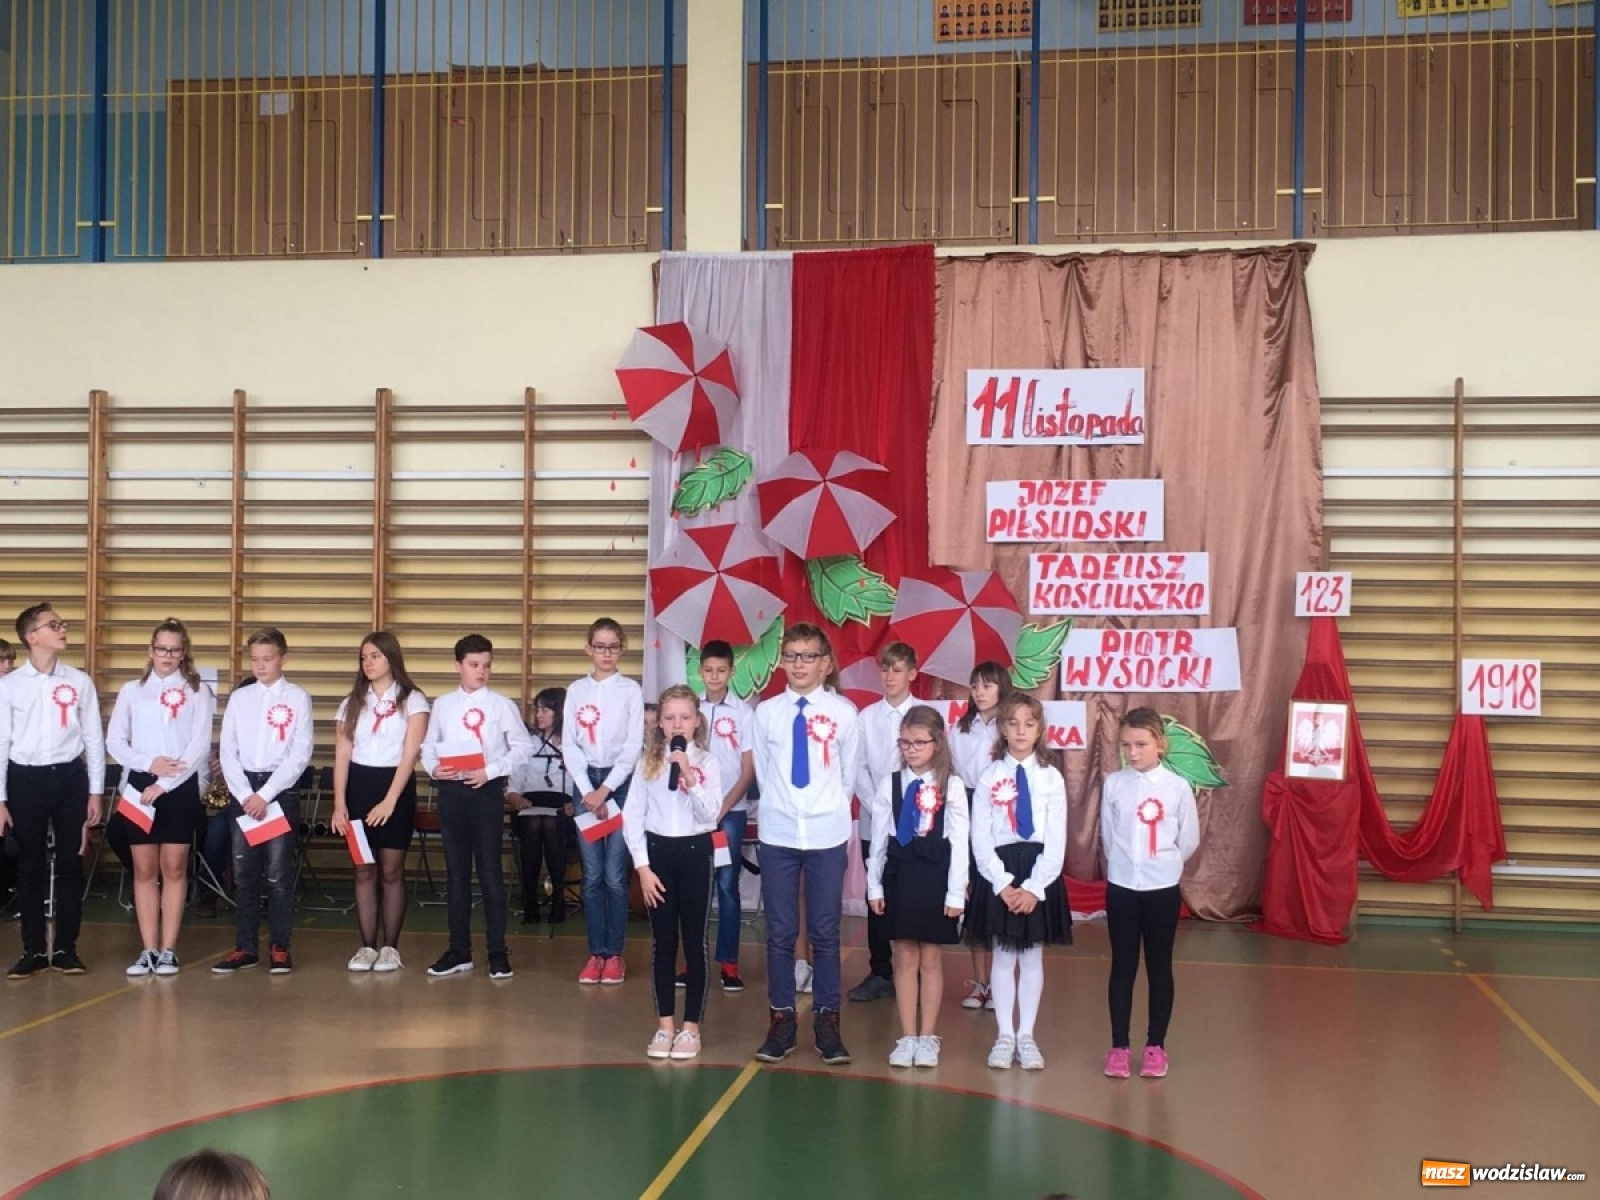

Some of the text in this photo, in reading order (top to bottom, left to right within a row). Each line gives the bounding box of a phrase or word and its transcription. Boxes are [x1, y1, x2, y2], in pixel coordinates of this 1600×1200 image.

[972, 376, 1021, 438] 11
[1037, 554, 1186, 580] TADEUSZ
[1300, 575, 1344, 613] 123
[1101, 630, 1201, 656] PIOTR
[1066, 655, 1213, 688] WYSOCKI
[1467, 663, 1537, 710] 1918
